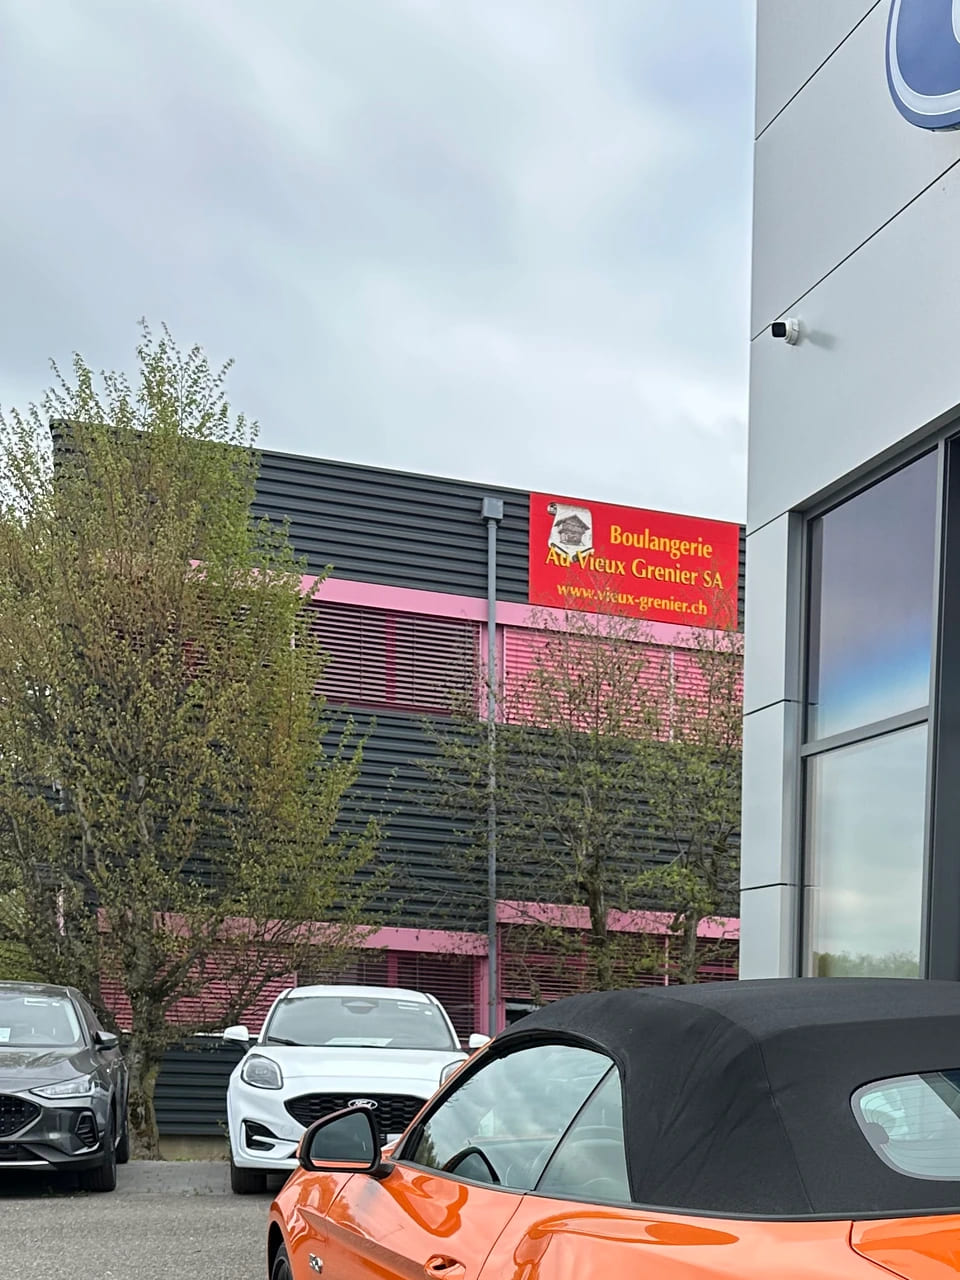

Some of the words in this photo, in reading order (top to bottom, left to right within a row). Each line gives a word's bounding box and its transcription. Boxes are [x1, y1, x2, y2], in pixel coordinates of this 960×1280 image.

[610, 525, 713, 559] Boulangerie
[545, 548, 571, 567] Au
[577, 551, 626, 575] Vieux
[631, 558, 699, 586] Grenier
[702, 570, 725, 590] SA
[557, 584, 707, 615] www.vieux-grenier.ch
